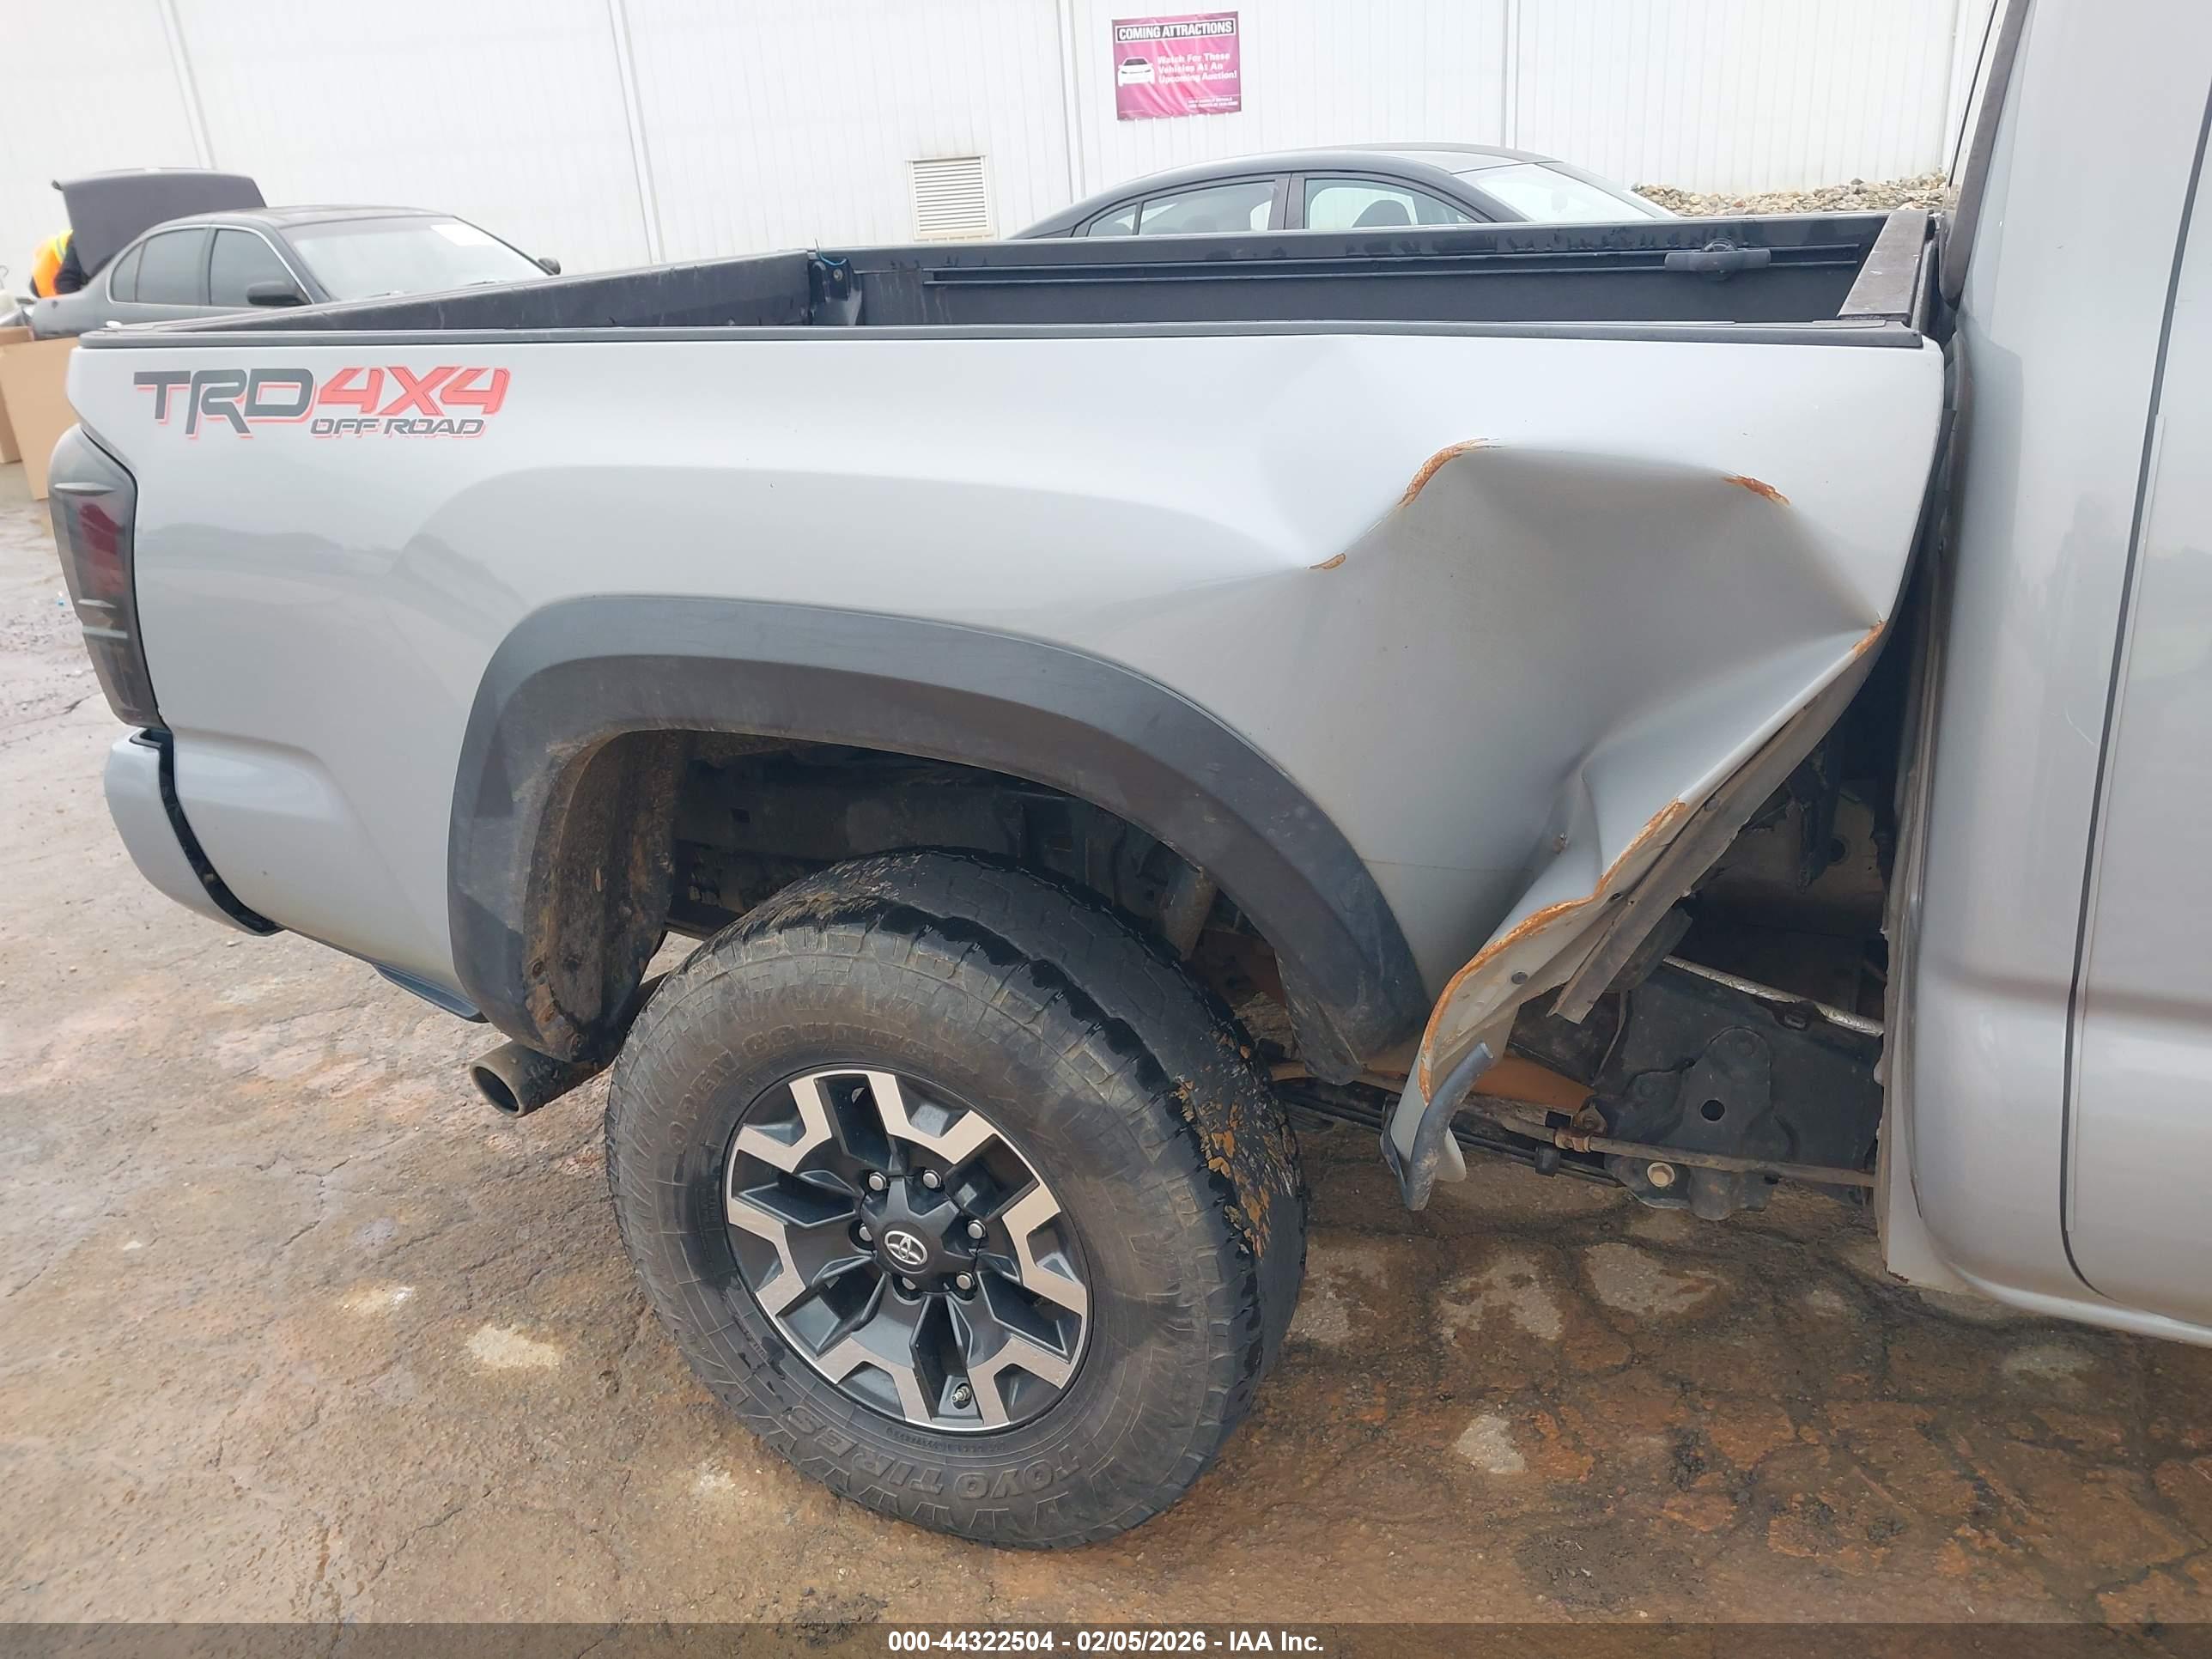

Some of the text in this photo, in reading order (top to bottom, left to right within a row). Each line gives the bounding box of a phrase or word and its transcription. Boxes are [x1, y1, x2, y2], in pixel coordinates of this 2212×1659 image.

[1118, 21, 1232, 40] COMING ATTRACTIONS
[1158, 55, 1185, 64] Watch
[1203, 52, 1230, 61] These
[1158, 62, 1224, 74] Vehicles At An
[1158, 70, 1237, 84] Upcoming Auction!
[134, 366, 511, 439] TRD 4X4
[309, 418, 485, 438] OFF ROAD
[782, 1404, 1083, 1500] TOYO TIRES
